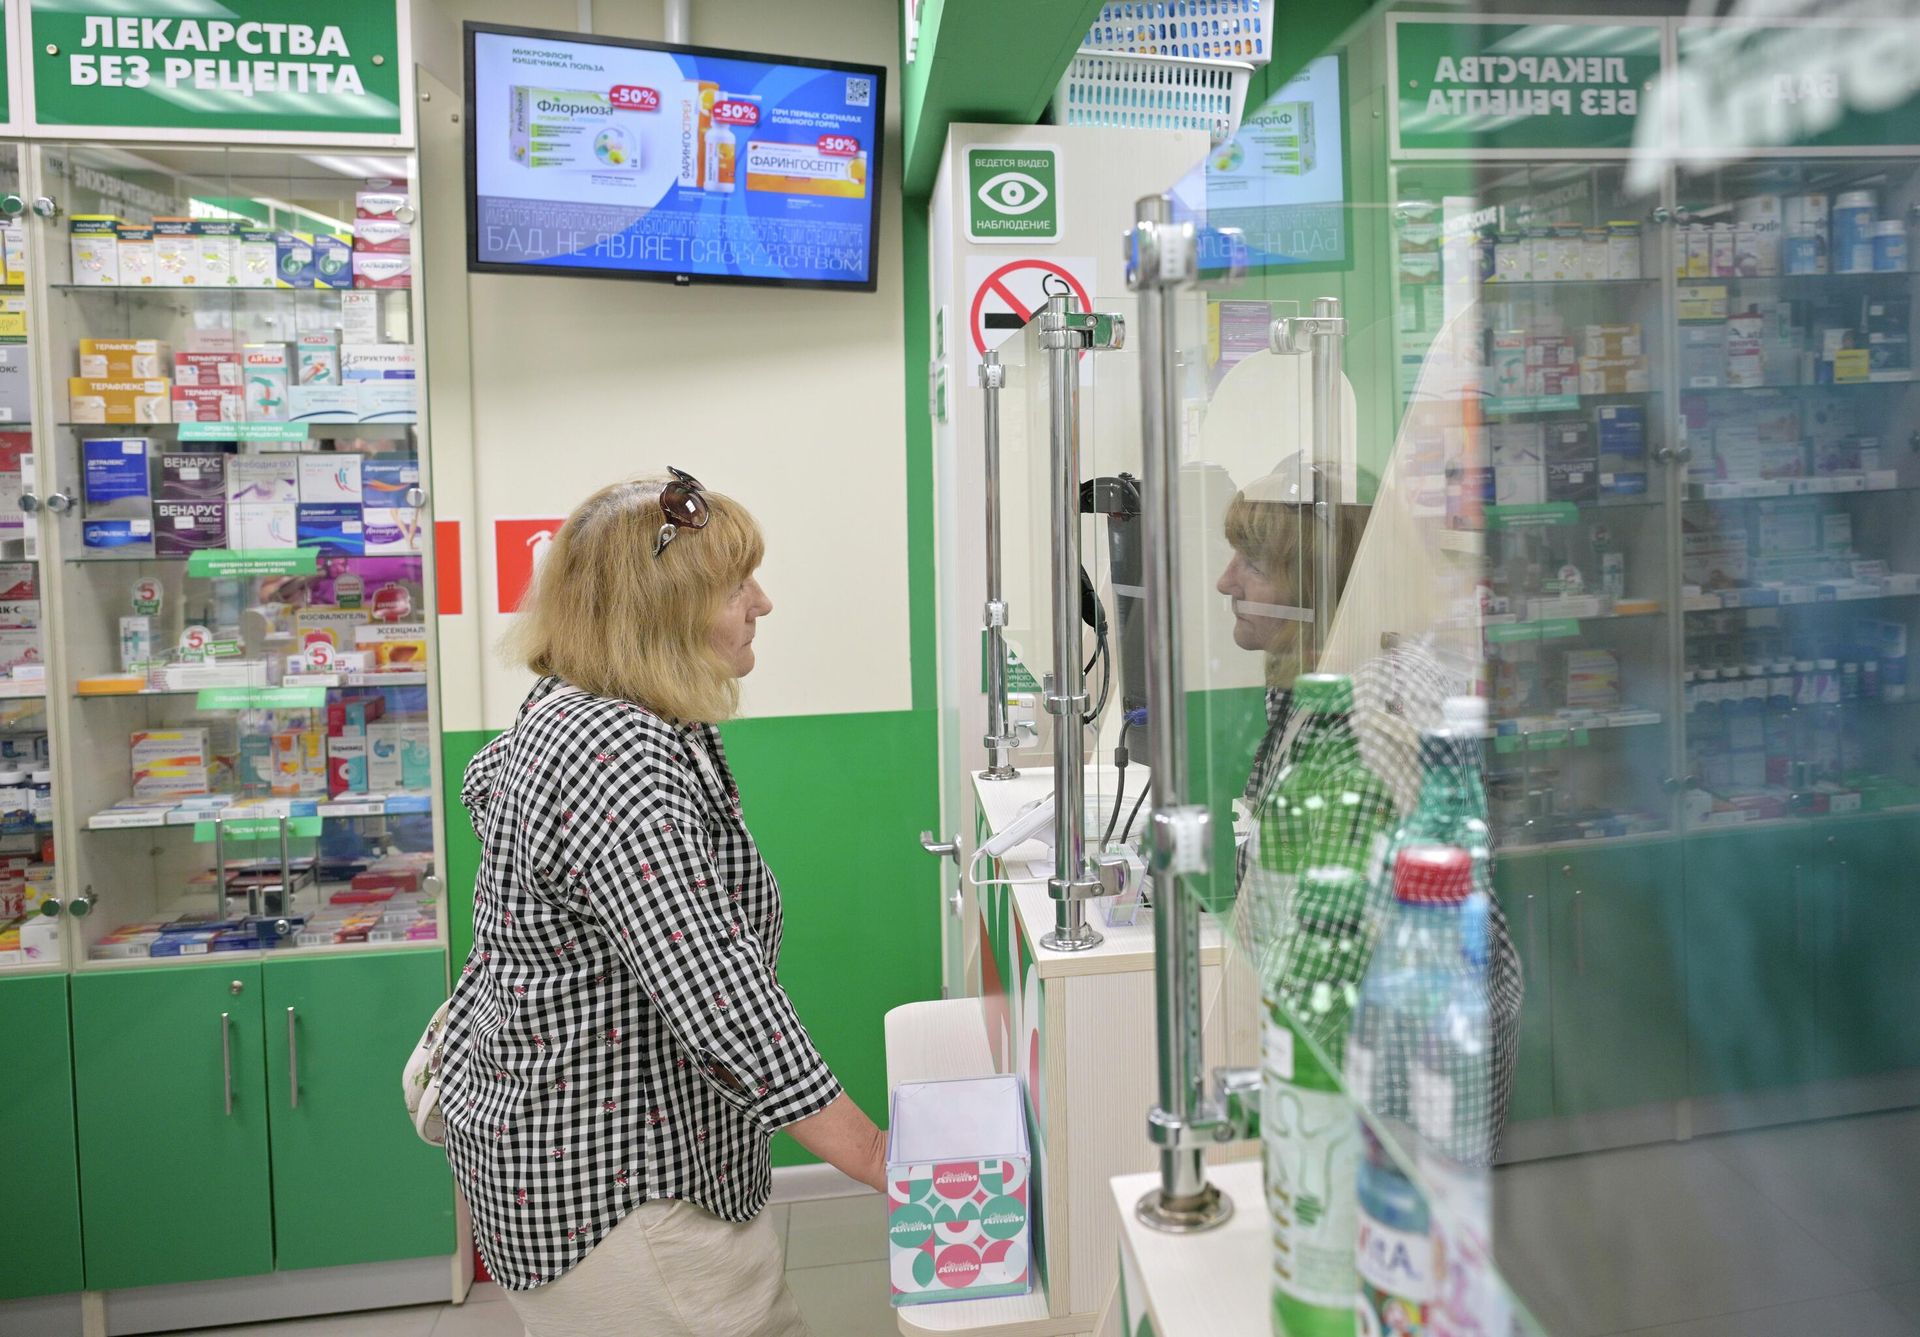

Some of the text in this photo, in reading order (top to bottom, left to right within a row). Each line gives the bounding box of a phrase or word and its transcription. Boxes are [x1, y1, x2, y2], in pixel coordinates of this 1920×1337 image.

[81, 16, 351, 57] ЛЕКАРСТВА
[512, 48, 574, 61] МИКРОФЛОРЕ
[512, 57, 605, 73] КИШЕЧНИКА ПОЛЬЗА
[69, 54, 366, 97] БЕЗ РЕЦЕПТА
[611, 88, 657, 105] -50%
[536, 99, 614, 117] Флориоза
[714, 104, 757, 120] -50%
[772, 108, 862, 123] ПРИ ПЕРВЫХ СИГНАЛАХ
[772, 116, 840, 129] БОЛЬНОГО ГОРЛА
[818, 137, 857, 152] -50%
[975, 158, 1049, 168] ВЕДЕТСЯ ВИДЕО
[976, 219, 1051, 231] НАБЛЮДЕНИЕ
[487, 225, 721, 264] БАД. НЕ ЯВЛЯЕТСЯ
[722, 240, 863, 260] ЛЕКАРСТВЕННЫМ
[721, 251, 862, 272] СРЕДСТВОМ
[164, 457, 221, 468] ВЕНАРУС
[159, 504, 222, 516] ВЕНАРУС
[313, 648, 327, 666] 5
